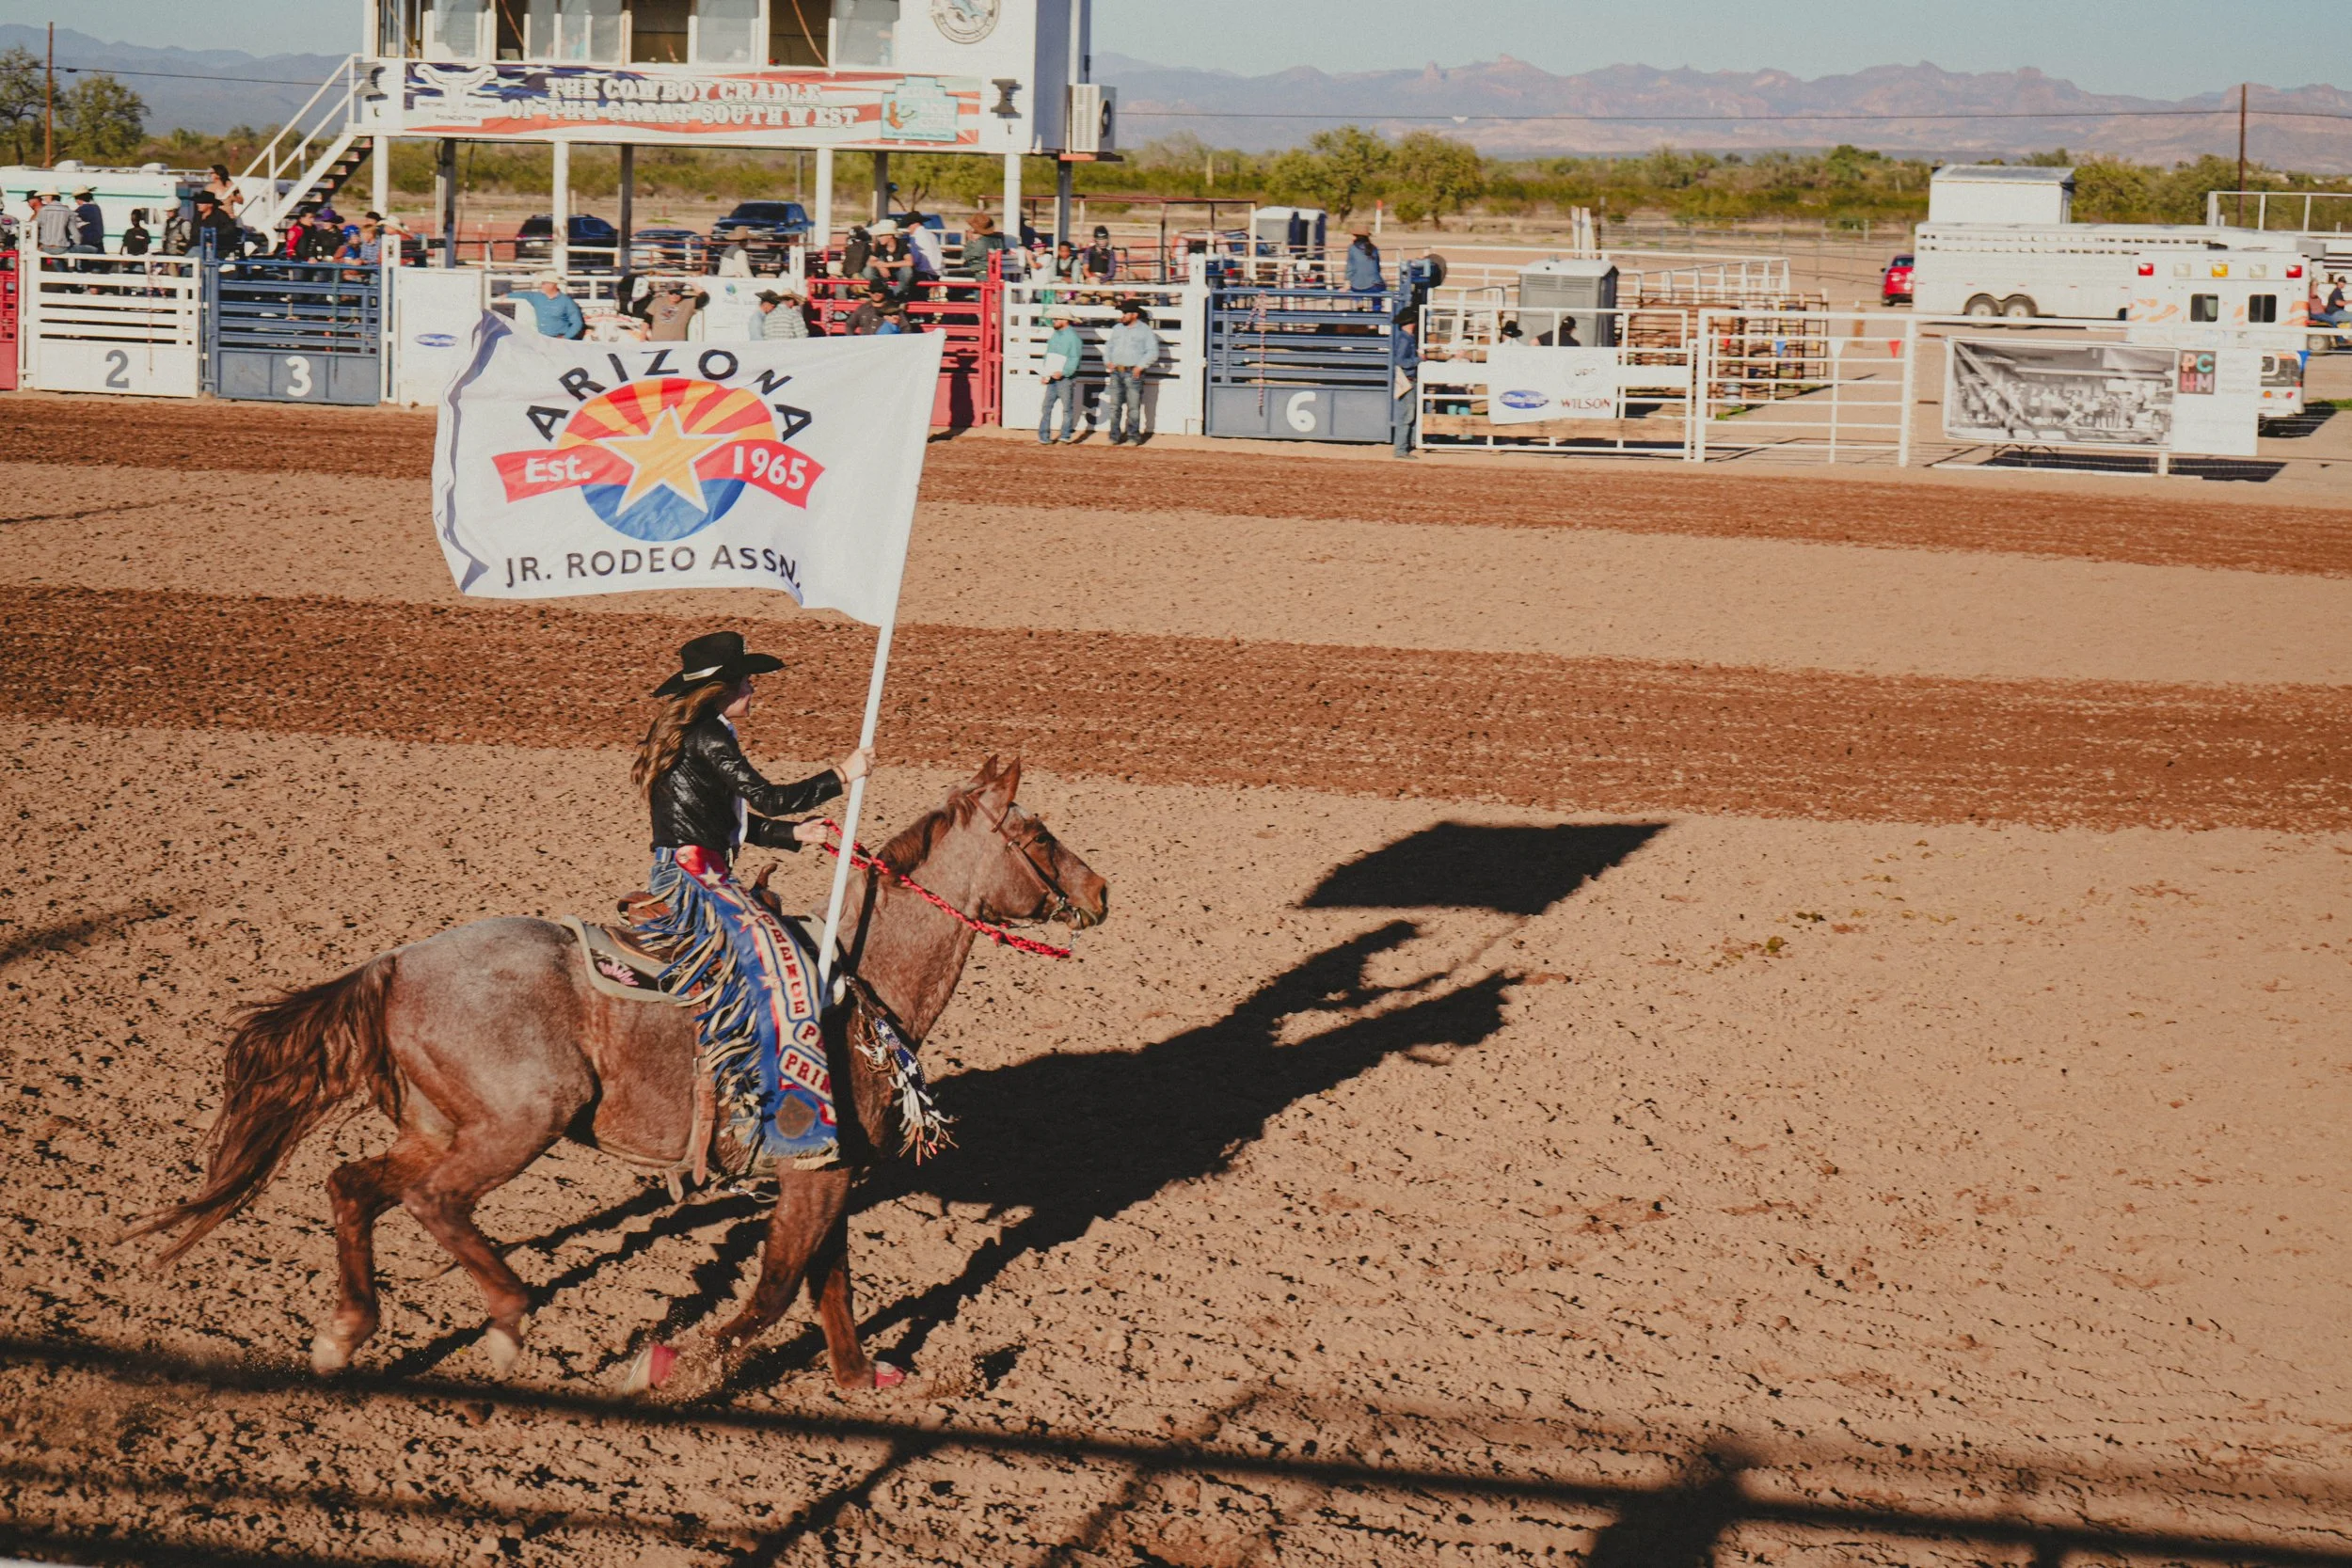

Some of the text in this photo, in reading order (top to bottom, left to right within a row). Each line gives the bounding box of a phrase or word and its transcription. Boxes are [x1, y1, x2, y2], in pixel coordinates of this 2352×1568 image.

[546, 77, 822, 104] THE COWBOY CRADLE
[507, 99, 860, 128] OF THE GREAT SOUTHWEST
[105, 349, 130, 388] 2
[285, 356, 312, 397] 3
[525, 348, 813, 441] ARIZONA
[1082, 383, 1111, 425] 5
[1286, 390, 1316, 433] 6
[1561, 398, 1611, 409] WILSON
[525, 445, 807, 491] Est. 1965
[505, 544, 801, 589] JR. RODEO ASSN.
